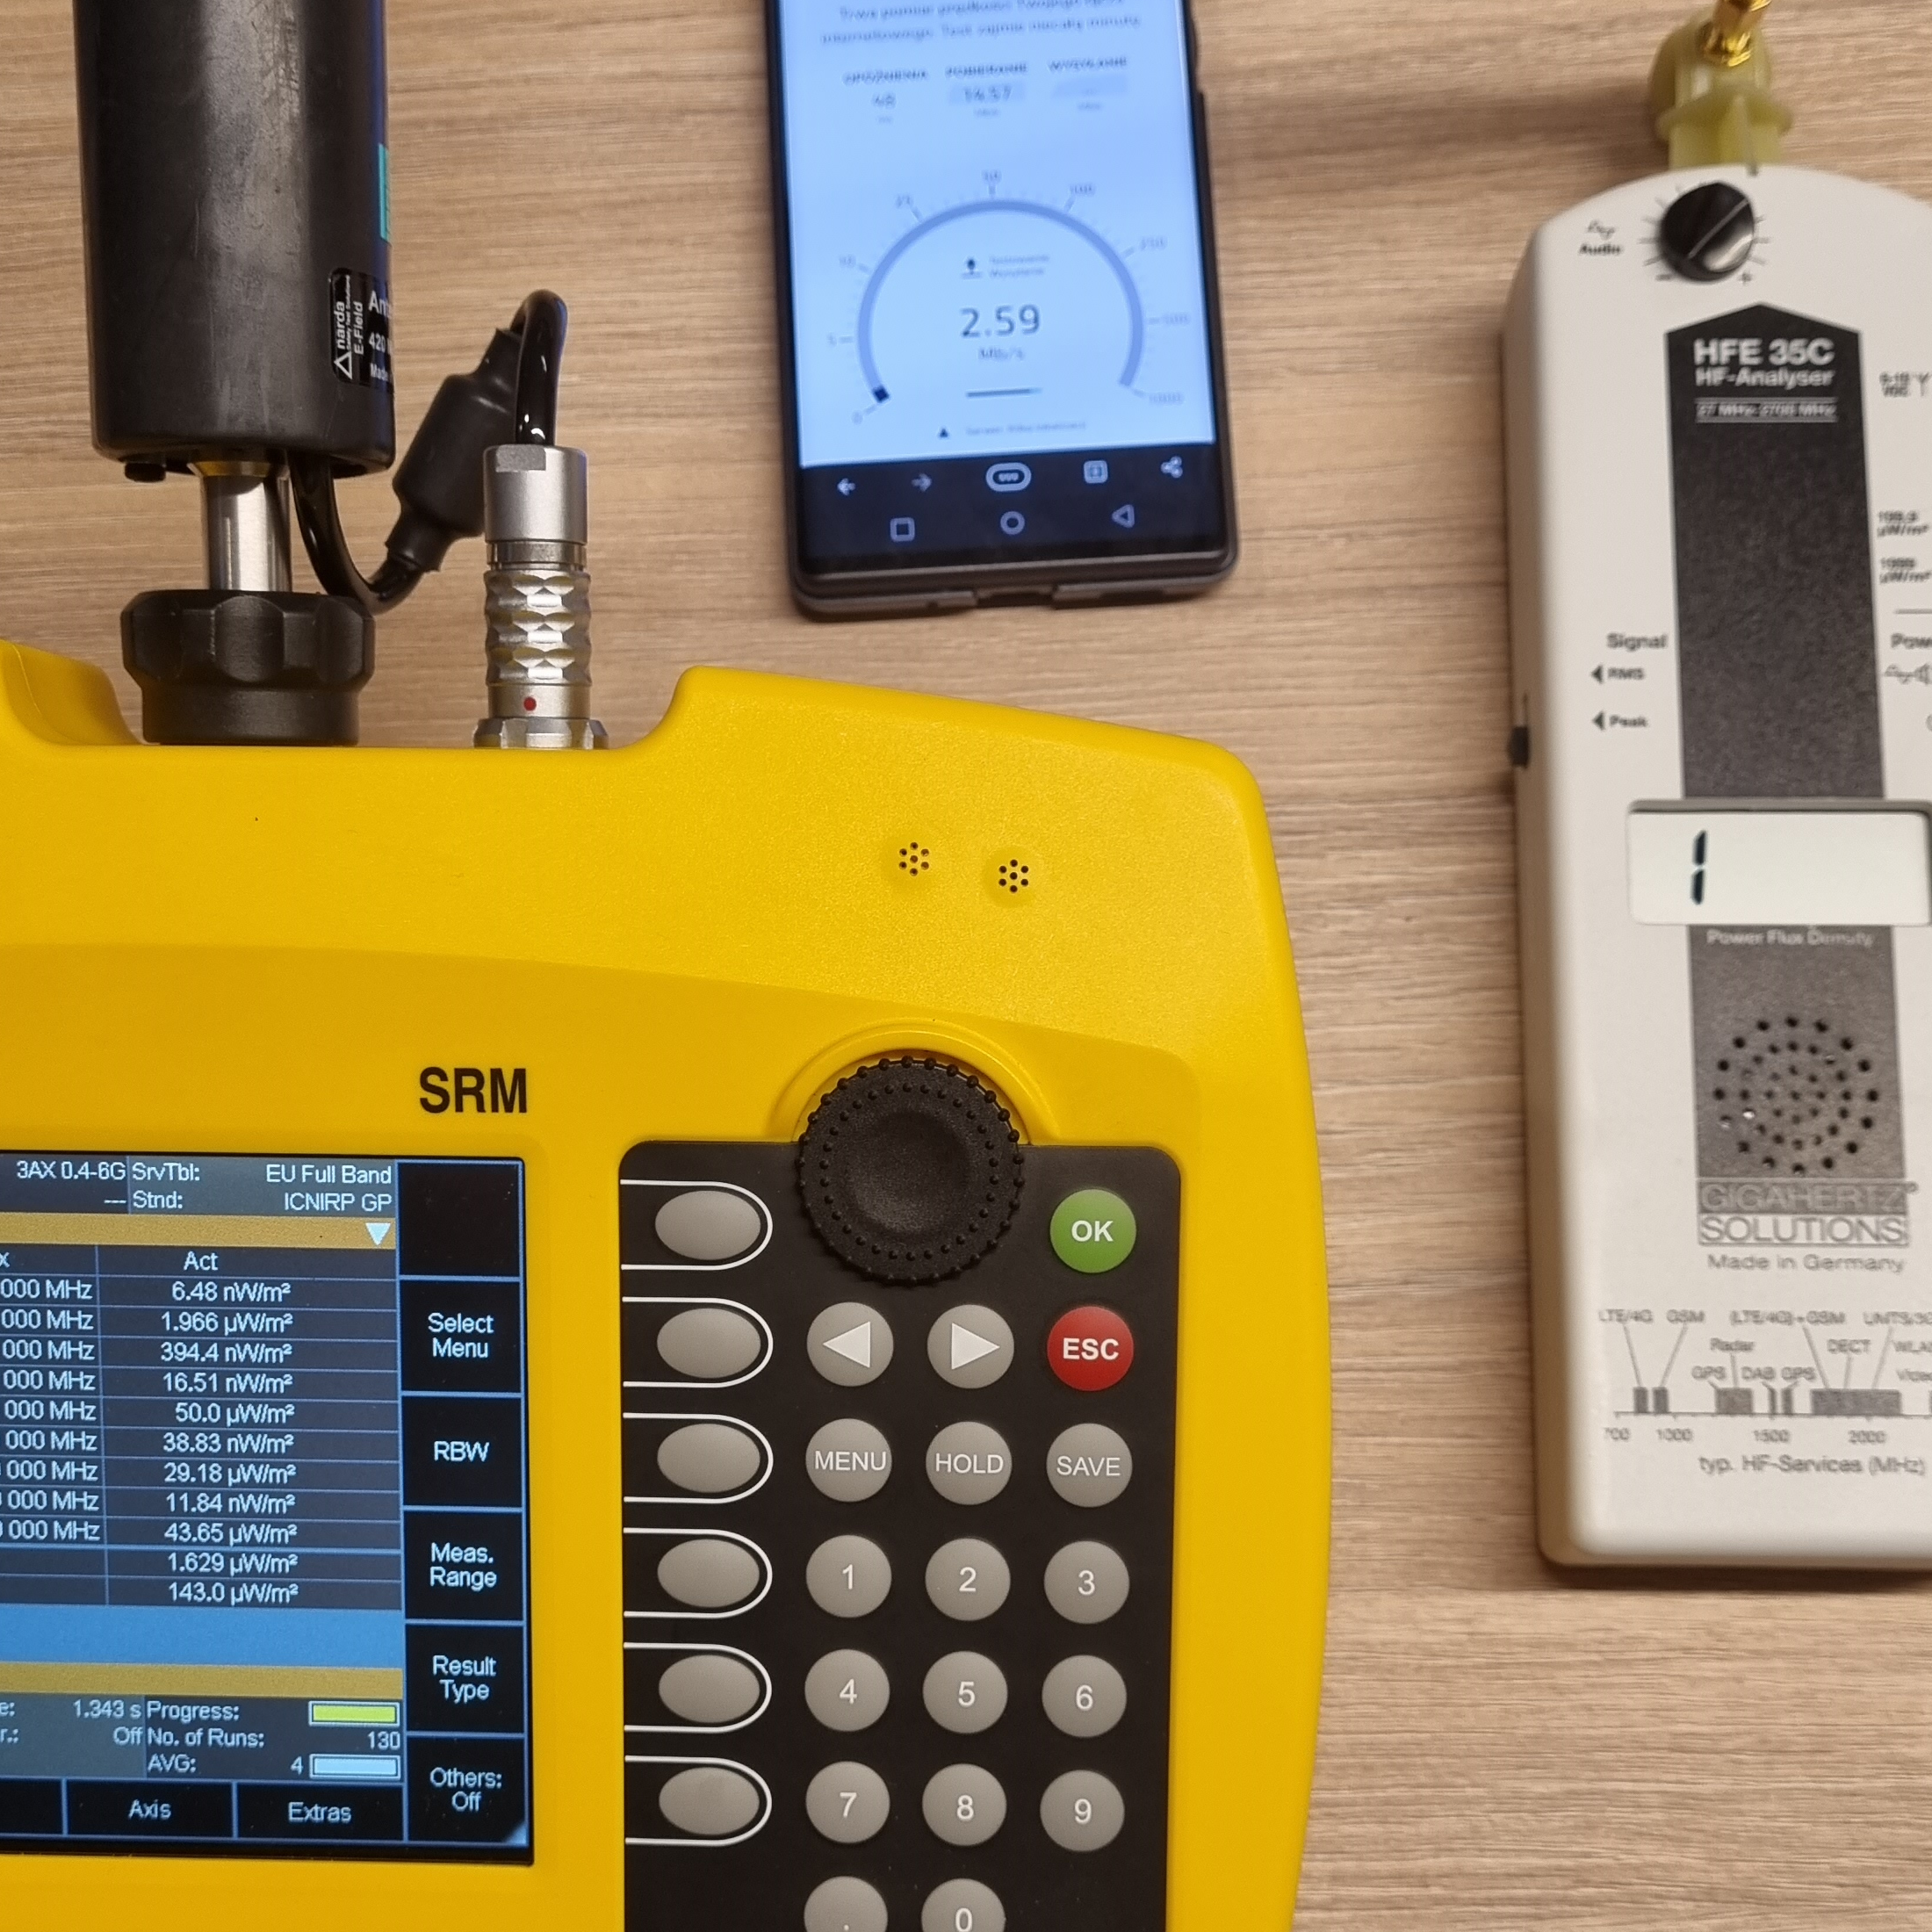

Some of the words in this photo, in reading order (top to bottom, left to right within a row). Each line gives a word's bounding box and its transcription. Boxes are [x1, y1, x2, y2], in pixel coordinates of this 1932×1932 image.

[334, 300, 346, 350] narda
[353, 301, 364, 355] E-Field
[960, 304, 1042, 339] 2.59
[1694, 337, 1764, 365] HFE
[1769, 337, 1835, 365] 35C
[1696, 366, 1835, 390] HF-Analyser
[1606, 632, 1667, 652] Signal
[1608, 666, 1644, 680] RMS
[1610, 714, 1647, 728] Peak
[420, 1066, 527, 1114] SRM
[17, 1160, 57, 1179] 3AX
[61, 1161, 126, 1180] 0.4-6G
[132, 1163, 201, 1184] SrvTbl:
[266, 1164, 296, 1183] EU
[301, 1164, 336, 1184] Full
[342, 1165, 393, 1185] Band
[133, 1191, 184, 1209] Stnd:
[284, 1193, 355, 1211] ICNIRP
[361, 1193, 393, 1212] GP
[1071, 1220, 1114, 1243] OK
[1701, 1217, 1906, 1244] SOLUTIONS
[184, 1252, 219, 1271] Act
[1707, 1254, 1769, 1271] Made
[1777, 1254, 1797, 1270] in
[1804, 1255, 1905, 1273] Germany
[1, 1279, 40, 1299] 000
[46, 1280, 93, 1299] MHz
[172, 1283, 217, 1301] 6.48
[224, 1283, 291, 1302] nW/m²
[2, 1309, 41, 1329] 000
[47, 1309, 94, 1330] MHz
[162, 1313, 219, 1331] 1.966
[428, 1313, 494, 1334] Select
[3, 1339, 42, 1359] 000
[47, 1340, 95, 1360] MHz
[161, 1343, 220, 1361] 394.4
[225, 1344, 292, 1363] nW/m²
[432, 1337, 488, 1358] Menu
[1063, 1337, 1120, 1361] ESC
[4, 1370, 43, 1389] 000
[48, 1371, 96, 1390] MHz
[163, 1373, 219, 1392] 16.51
[226, 1373, 293, 1394] nW/m²
[4, 1400, 44, 1420] 000
[49, 1401, 97, 1420] MHz
[176, 1403, 220, 1423] 50.0
[5, 1430, 45, 1450] 000
[51, 1431, 97, 1451] MHz
[163, 1434, 221, 1453] 38.83
[227, 1434, 294, 1453] nW/m²
[433, 1441, 489, 1461] RBW
[6, 1460, 46, 1480] 000
[52, 1460, 98, 1481] MHz
[814, 1450, 888, 1473] MENU
[934, 1452, 1004, 1475] HOLD
[1056, 1455, 1121, 1477] SAVE
[1698, 1455, 1734, 1475] typ.
[1742, 1455, 1863, 1473] HF-Services
[1869, 1457, 1925, 1476] (MHz)
[164, 1464, 222, 1483] 29.18
[7, 1490, 47, 1510] 000
[53, 1490, 99, 1510] MHz
[165, 1495, 223, 1513] 11.84
[228, 1495, 295, 1515] nW/m²
[8, 1520, 47, 1539] 000
[54, 1520, 100, 1540] MHz
[164, 1524, 224, 1543] 43.65
[168, 1554, 225, 1573] 1.629
[430, 1543, 494, 1563] Meas.
[429, 1568, 497, 1591] Range
[841, 1565, 855, 1590] 1
[959, 1567, 977, 1592] 2
[1078, 1570, 1096, 1596] 3
[169, 1583, 225, 1603] 143.0
[432, 1655, 496, 1676] Result
[440, 1681, 489, 1702] Type
[839, 1679, 858, 1705] 4
[957, 1682, 976, 1707] 5
[1076, 1686, 1094, 1712] 6
[73, 1699, 125, 1719] 1.343
[130, 1705, 141, 1719] s
[146, 1701, 240, 1724] Progress:
[113, 1727, 143, 1746] Off
[148, 1727, 180, 1747] No.
[184, 1727, 203, 1747] of
[208, 1728, 265, 1748] Runs:
[368, 1730, 401, 1750] 130
[148, 1753, 197, 1773] AVG:
[291, 1756, 303, 1775] 4
[430, 1768, 503, 1789] Others:
[128, 1800, 171, 1820] Axis
[288, 1802, 352, 1823] Extras
[451, 1792, 482, 1812] Off
[839, 1793, 857, 1818] 7
[956, 1795, 975, 1821] 8
[1074, 1799, 1092, 1825] 9
[955, 1907, 973, 1932] 0
